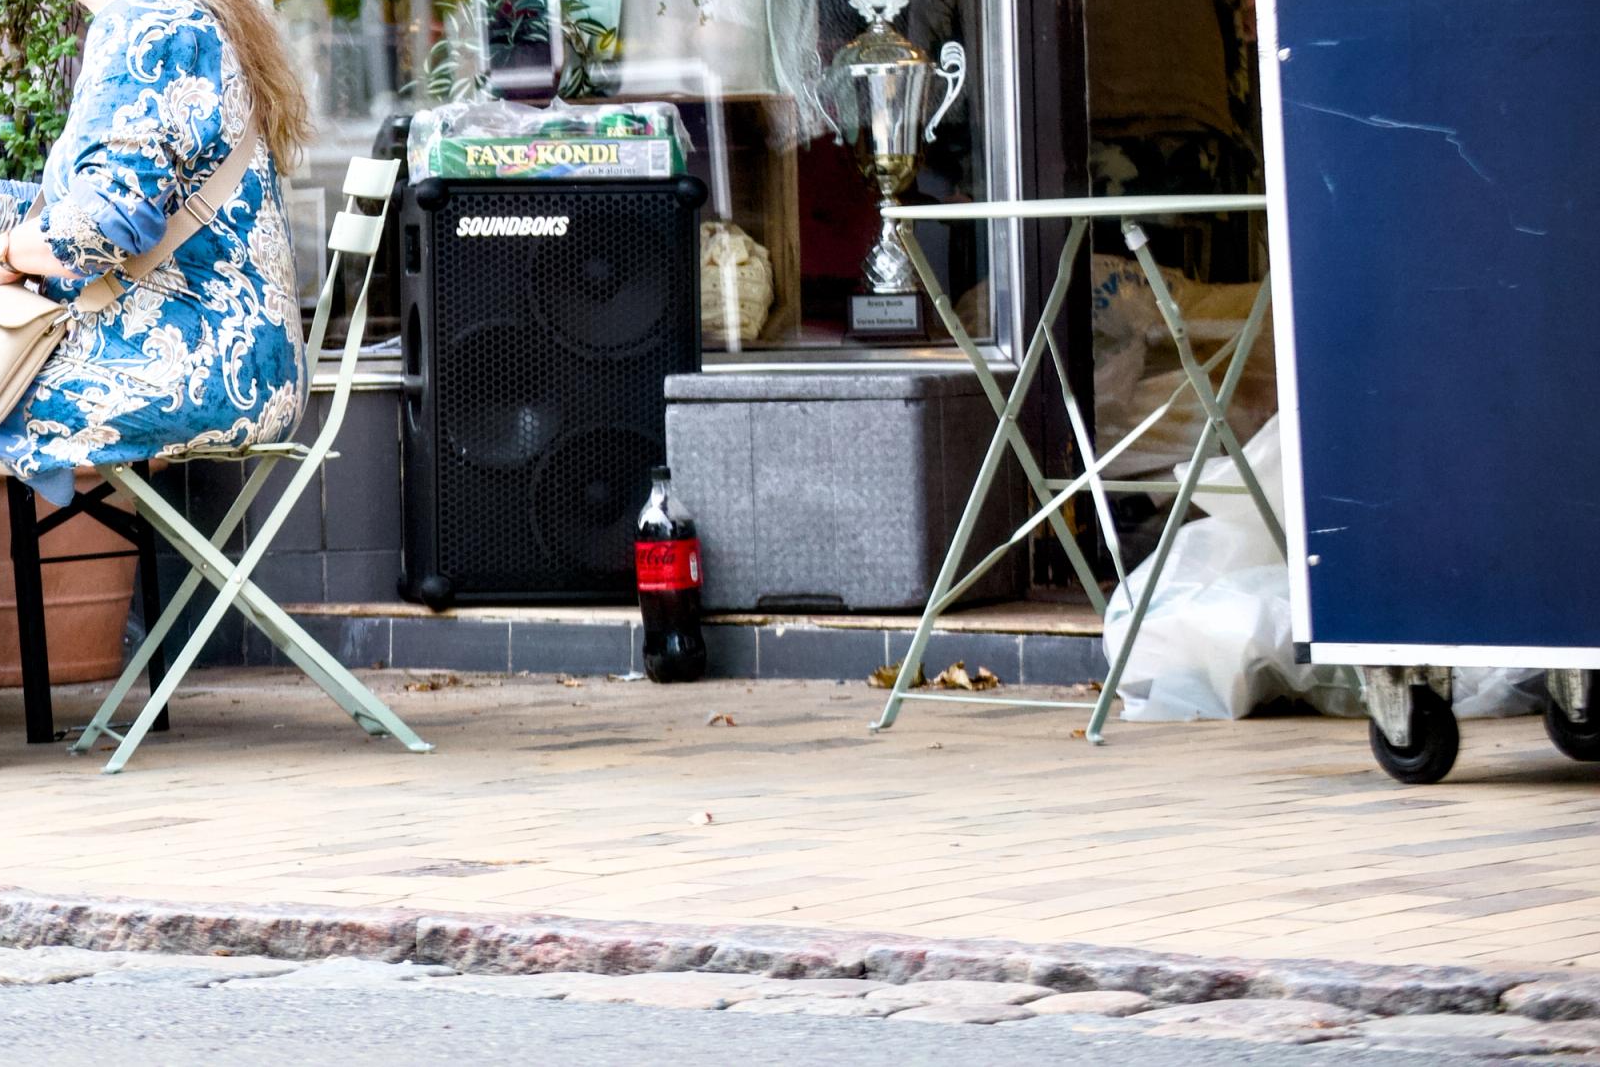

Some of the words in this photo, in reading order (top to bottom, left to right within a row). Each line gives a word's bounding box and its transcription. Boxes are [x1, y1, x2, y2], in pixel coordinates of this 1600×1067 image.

[465, 145, 529, 167] FAXE
[536, 143, 620, 164] KONDI
[456, 215, 570, 237] SOUNDBOKS
